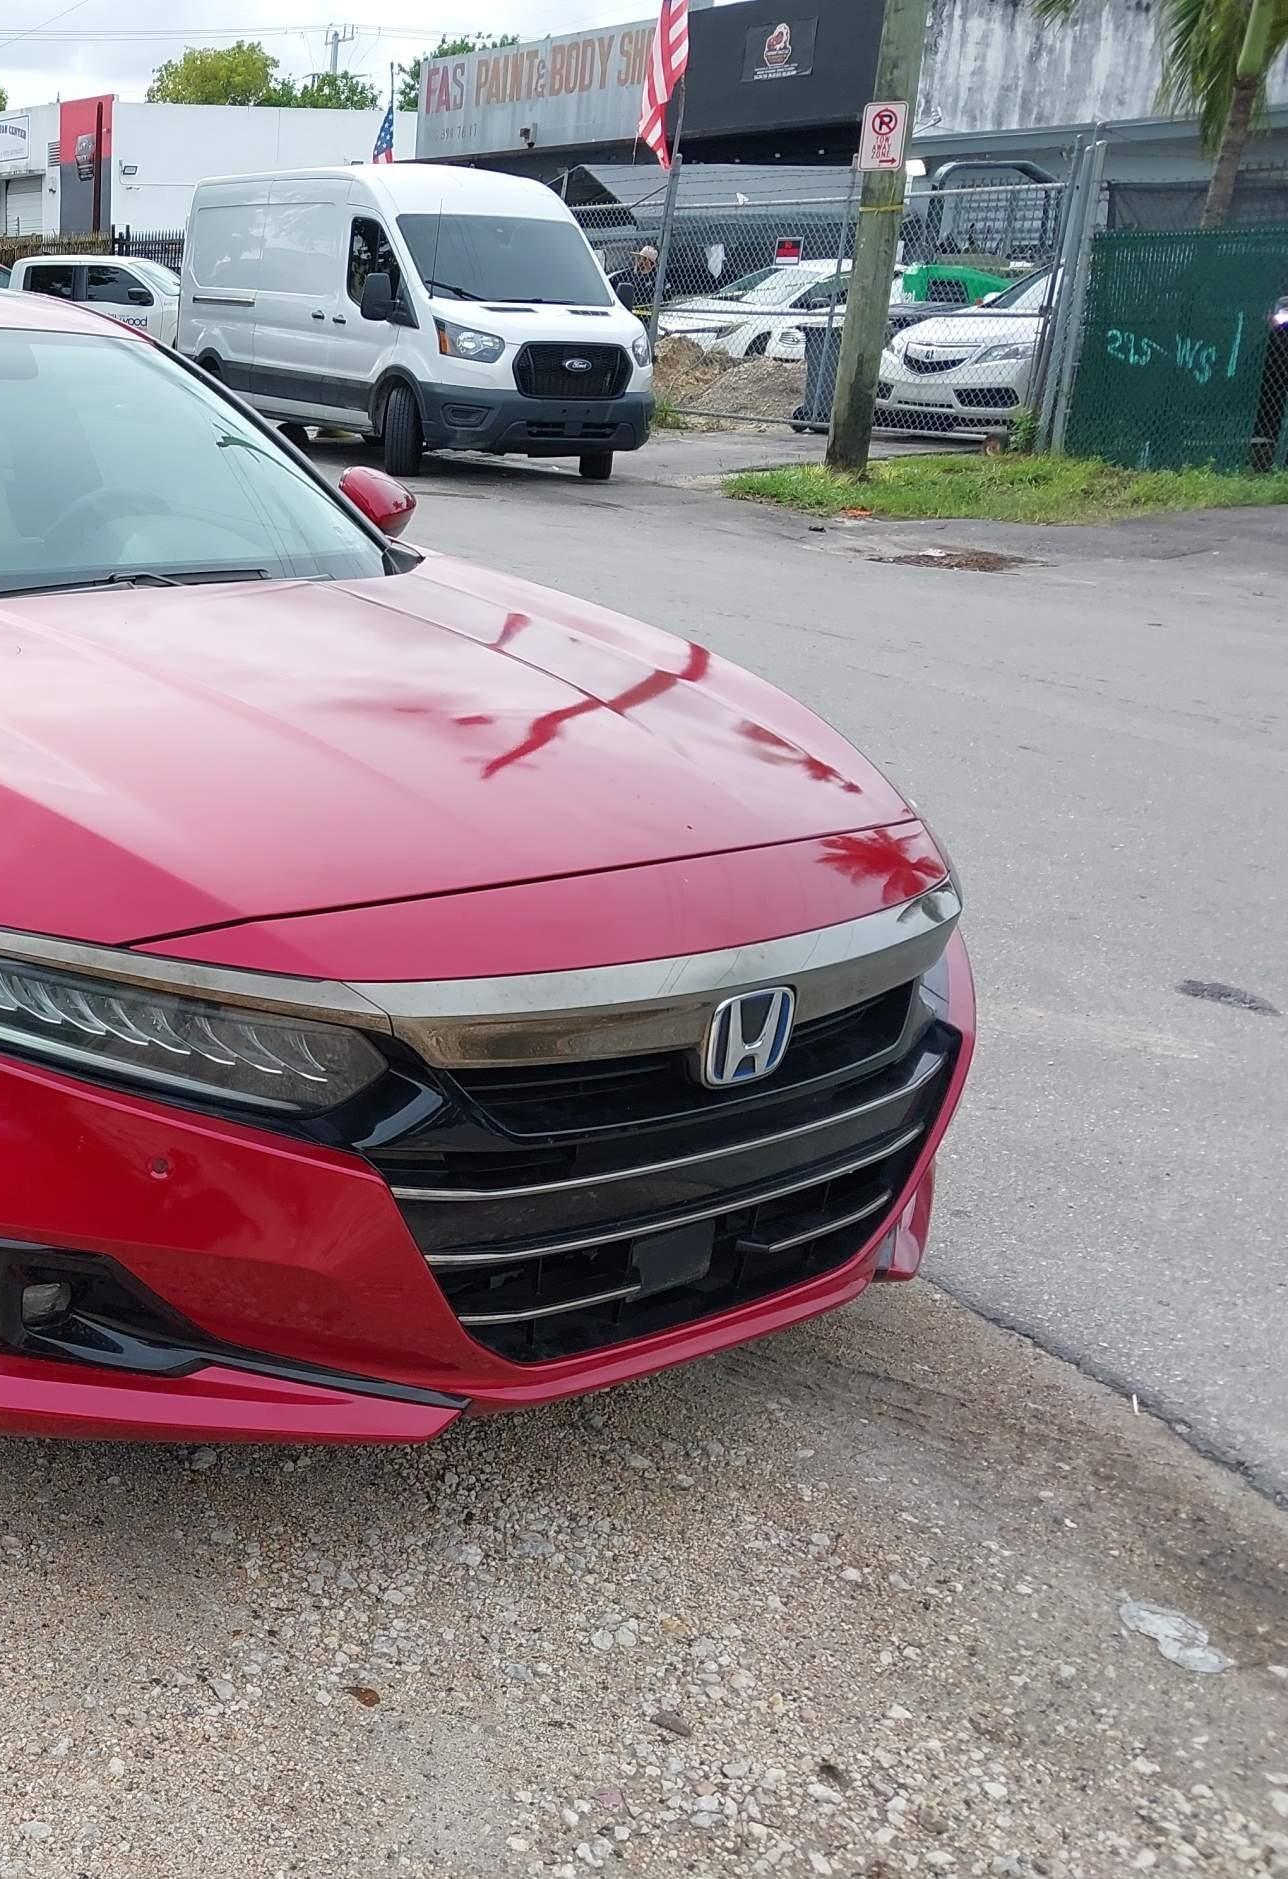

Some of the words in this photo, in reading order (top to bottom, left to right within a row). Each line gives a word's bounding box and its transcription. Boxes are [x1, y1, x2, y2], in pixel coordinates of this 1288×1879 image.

[475, 50, 539, 107] PAINT
[534, 58, 547, 99] &
[549, 35, 615, 97] BODY
[8, 125, 27, 141] CENTER
[876, 136, 891, 145] TOW
[872, 143, 892, 152] AWAY
[871, 151, 891, 159] ZONE
